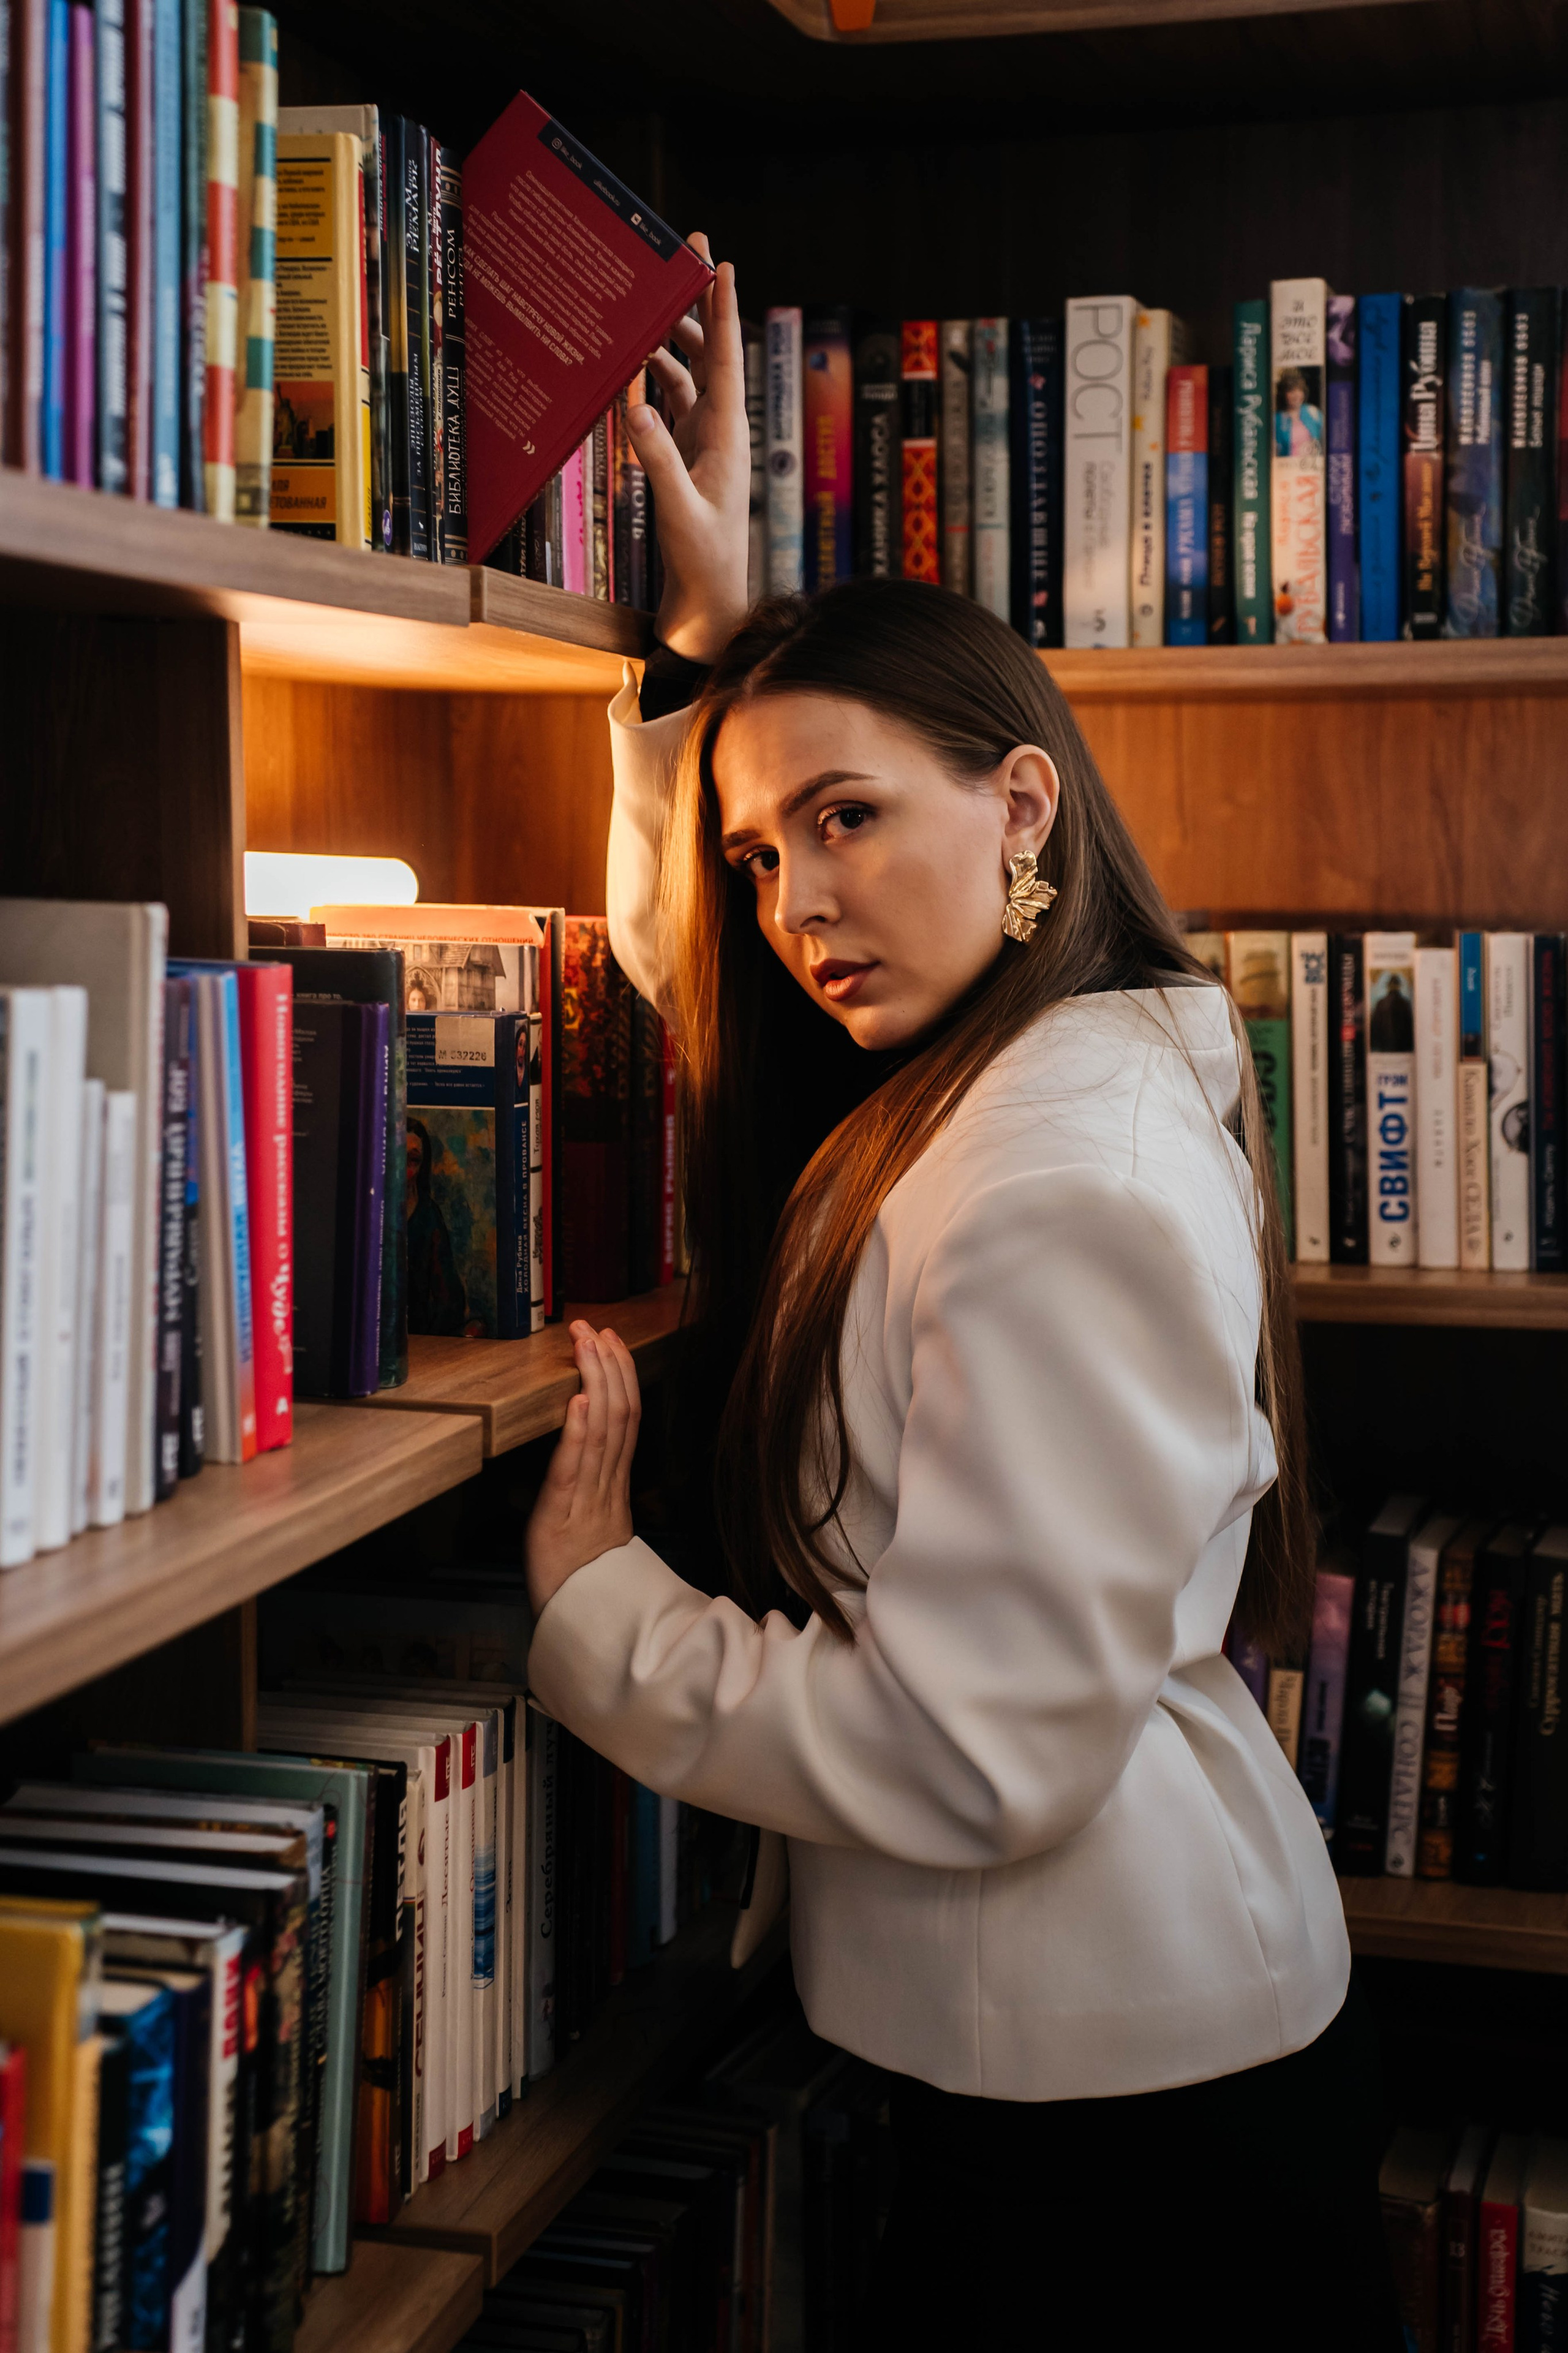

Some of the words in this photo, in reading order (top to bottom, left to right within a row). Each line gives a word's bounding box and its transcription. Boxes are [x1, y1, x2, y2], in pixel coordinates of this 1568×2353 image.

[447, 229, 456, 318] РЕНСОМ
[461, 243, 475, 258] КАК
[473, 255, 499, 282] СДЕЛАТЬ
[499, 279, 513, 293] ШАГ
[511, 291, 545, 323] НАВСТРЕЧУ
[543, 321, 564, 342] НОВОЙ
[562, 339, 584, 365] ЖИЗНИ,
[479, 276, 506, 304] МОЖЕШЬ
[505, 301, 540, 338] ВЫМОЛВИТЬ
[548, 342, 573, 366] СЛОВА?
[446, 366, 460, 408] ДУШ
[1071, 303, 1123, 454] РОСТ
[1237, 322, 1262, 390] Лариса
[1408, 322, 1443, 401] Рубина
[417, 461, 421, 476] ЗА
[447, 414, 462, 514] БИБЛИОТЕКА
[1235, 394, 1263, 499] Рубальская
[1409, 403, 1442, 456] Дина
[270, 497, 327, 508] ЕТОВАННАЯ
[631, 470, 645, 540] НОЧЬ
[1031, 401, 1048, 580] ОПОЗДАВШИЕ
[1295, 475, 1321, 633] РУБАЛЬСКАЯ
[276, 992, 288, 1128] Новогодние
[273, 1133, 287, 1236] рассказы
[1378, 1092, 1409, 1223] СВИФТ
[546, 1722, 556, 1766] луч
[395, 1796, 407, 1943] ПЕТЛЯ
[541, 1776, 554, 1939] Серебряный
